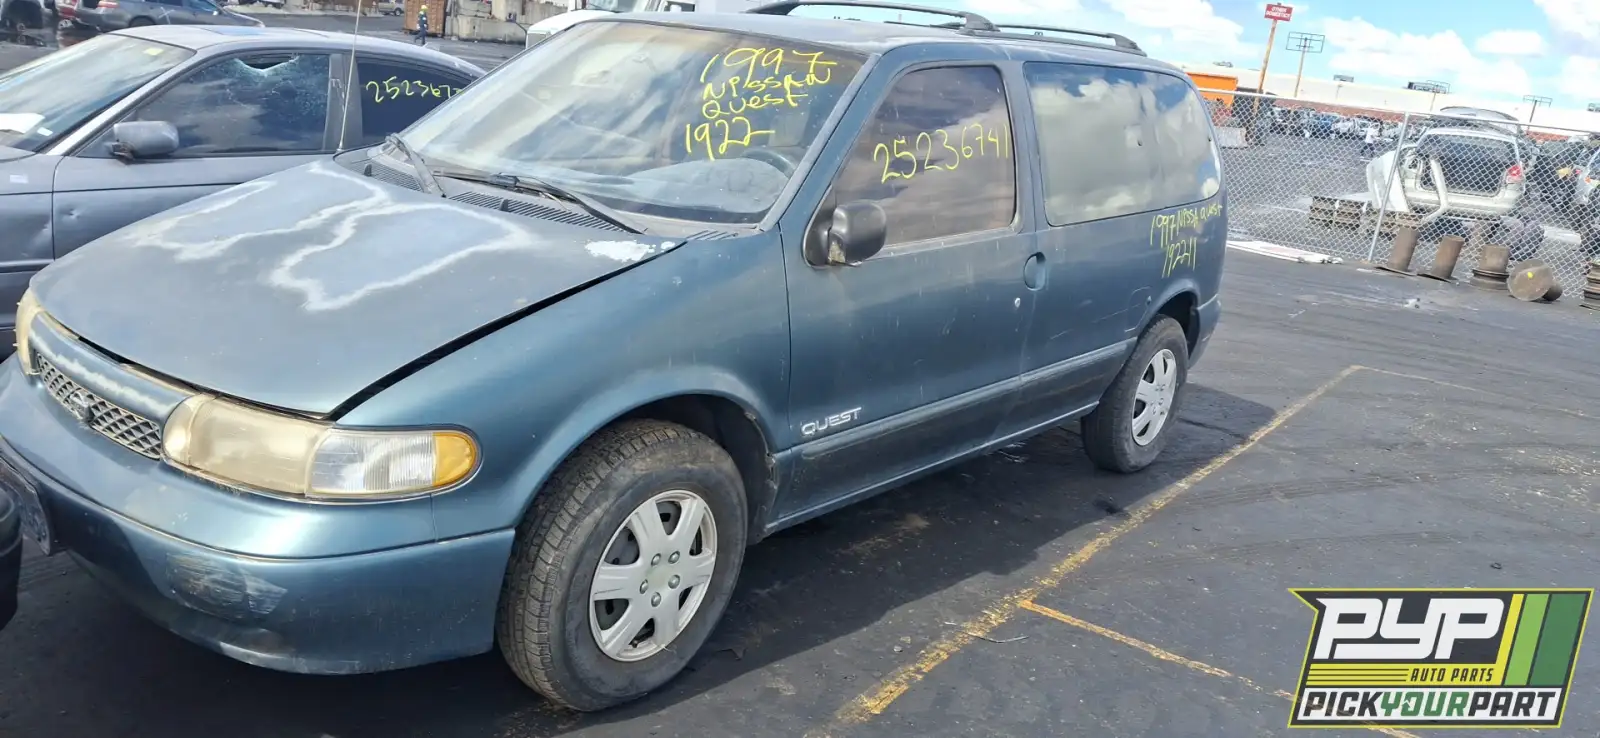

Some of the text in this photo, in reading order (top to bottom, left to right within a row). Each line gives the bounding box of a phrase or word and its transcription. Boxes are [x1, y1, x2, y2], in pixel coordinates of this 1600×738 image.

[700, 48, 837, 88] 1997
[873, 122, 1009, 184] 25236741
[801, 406, 862, 435] QUEST
